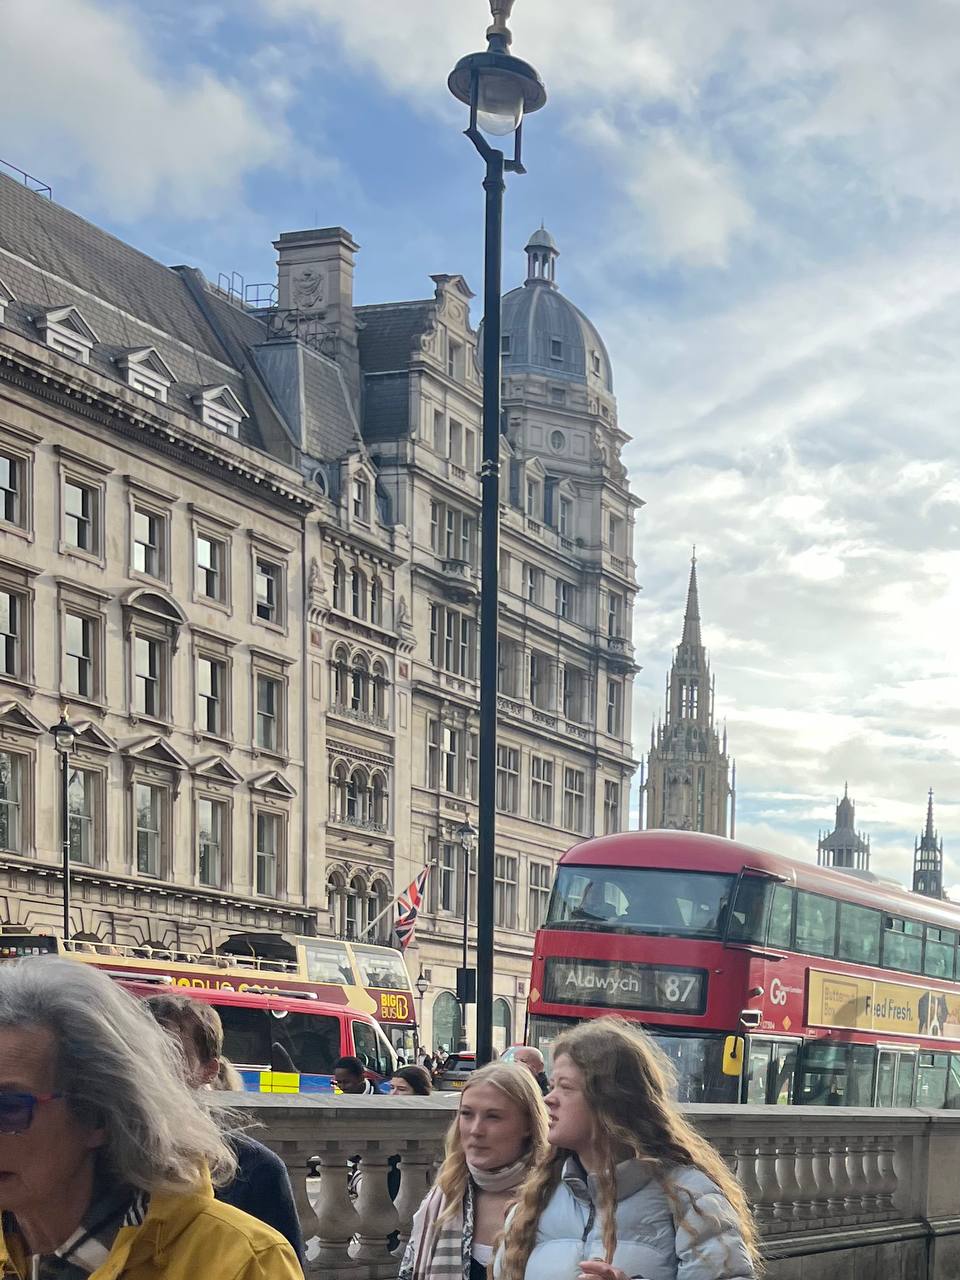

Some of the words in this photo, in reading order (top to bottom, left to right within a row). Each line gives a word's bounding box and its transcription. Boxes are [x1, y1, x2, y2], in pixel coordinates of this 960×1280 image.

[565, 969, 639, 993] Aldwych
[665, 975, 696, 1002] 87
[770, 978, 787, 1006] Go
[380, 993, 396, 1007] BIG
[381, 1006, 397, 1019] BUS
[865, 995, 887, 1018] Feed
[888, 999, 914, 1021] Fresh.
